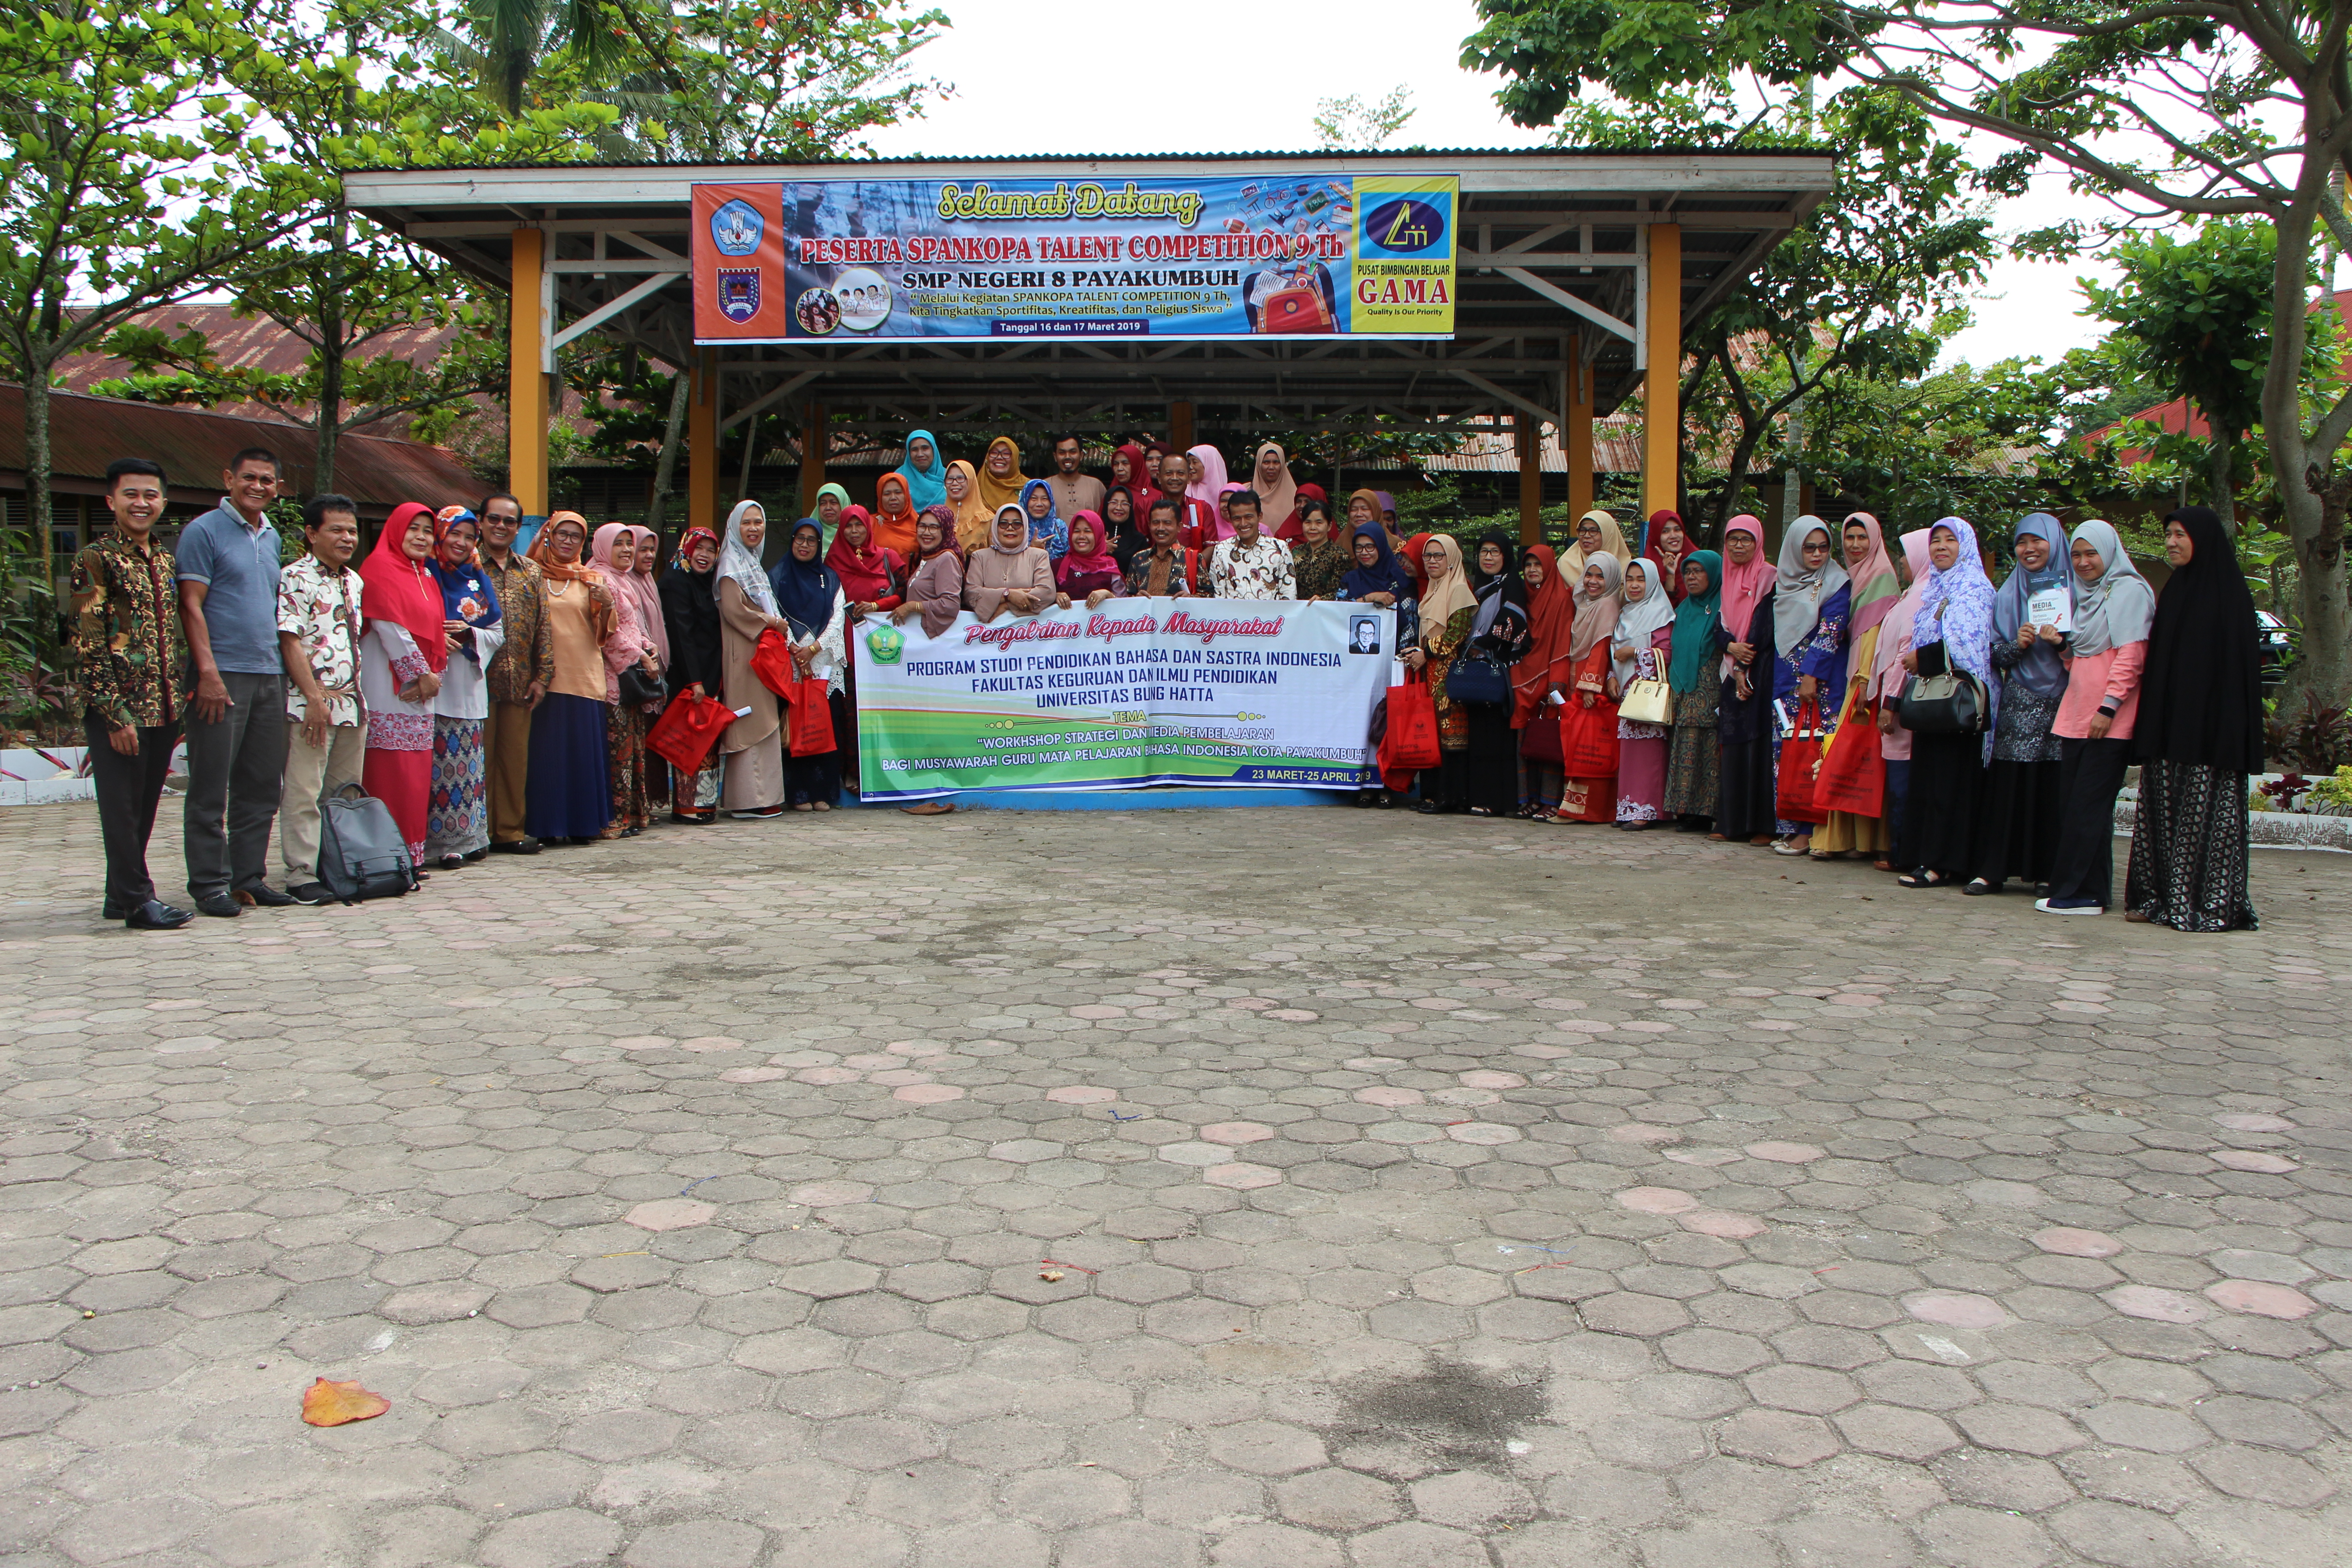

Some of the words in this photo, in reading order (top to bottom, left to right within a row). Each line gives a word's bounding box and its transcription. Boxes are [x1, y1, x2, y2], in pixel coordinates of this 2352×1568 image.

[937, 182, 1071, 218] Selamat
[1075, 182, 1202, 226] Datang
[800, 238, 903, 264] PESERTA
[907, 237, 1033, 262] SPANKOPA
[1037, 235, 1122, 260] TALENT
[1127, 233, 1291, 260] COMPETITION
[1295, 233, 1311, 259] 9
[1316, 233, 1345, 259] Th
[902, 272, 952, 289] SMP
[958, 272, 1045, 288] NEGERI
[1052, 271, 1066, 287] 8
[1072, 270, 1239, 287] PAYAKUMBUH
[1357, 265, 1379, 275] PUSAT
[1381, 265, 1419, 275] BIMBINGAN
[1421, 265, 1450, 275] BELAJAR
[920, 293, 960, 303] Melalui
[963, 293, 1010, 305] Kegiatan
[1013, 292, 1074, 302] SPANKOPA
[1077, 292, 1119, 301] TALENT
[1122, 291, 1200, 301] COMPETITION
[1204, 293, 1210, 302] 9
[1213, 291, 1230, 302] Th,
[1357, 279, 1449, 304] GAMA
[910, 307, 931, 316] Kita
[933, 307, 993, 318] Tingkatkan
[996, 305, 1056, 318] Sportifitas,
[1059, 304, 1119, 316] Kreatifitas,
[1122, 304, 1142, 314] dan
[1145, 304, 1188, 317] Religius
[1191, 304, 1223, 314] Siswa
[1000, 323, 1038, 334] Tanggal
[1040, 323, 1051, 332] 16
[1054, 323, 1071, 332] dan
[1074, 323, 1085, 331] 17
[1087, 322, 1115, 331] Maret
[1117, 322, 1140, 331] 2019
[2032, 601, 2052, 609] MEDIA
[964, 619, 1081, 652] Pengabdian
[1084, 613, 1158, 643] Kepada
[1160, 611, 1285, 644] Masyarakat
[907, 660, 976, 676] PROGRAM
[980, 657, 1023, 673] STUDI
[1027, 652, 1111, 671] PENDIDIKAN
[1116, 649, 1168, 664] BAHASA
[1173, 649, 1201, 664] DAN
[1206, 651, 1261, 665] SASTRA
[1266, 652, 1342, 667] INDONESIA
[972, 675, 1043, 693] FAKULTAS
[1048, 670, 1123, 688] KEGURUAN
[1128, 668, 1154, 683] DAN
[1156, 668, 1189, 682] ILMU
[1194, 670, 1278, 684] PENDIDIKAN
[1037, 689, 1128, 708] UNIVERSITAS
[1133, 686, 1165, 701] BUNG
[1170, 687, 1214, 701] HATTA
[1113, 710, 1147, 723] TEMA
[1064, 729, 1119, 745] STRATEGI
[1122, 728, 1147, 740] DAN
[1148, 725, 1180, 738] MEDIA
[1183, 726, 1274, 740] PEMBELAJARAN
[882, 759, 911, 771] BAGI
[914, 755, 998, 770] MUSYAWARAH
[1001, 752, 1035, 765] GURU
[1039, 750, 1073, 763] MATA
[1074, 745, 1142, 761] PELAJARAN
[1145, 743, 1180, 757] BAHASA
[1183, 744, 1249, 757] INDONESIA
[1252, 746, 1283, 758] KOTA
[1286, 746, 1367, 760] PAYAKUMBUH”
[1252, 769, 1264, 779] 23
[1267, 770, 1319, 780] MARET-25
[1321, 771, 1352, 782] APRIL
